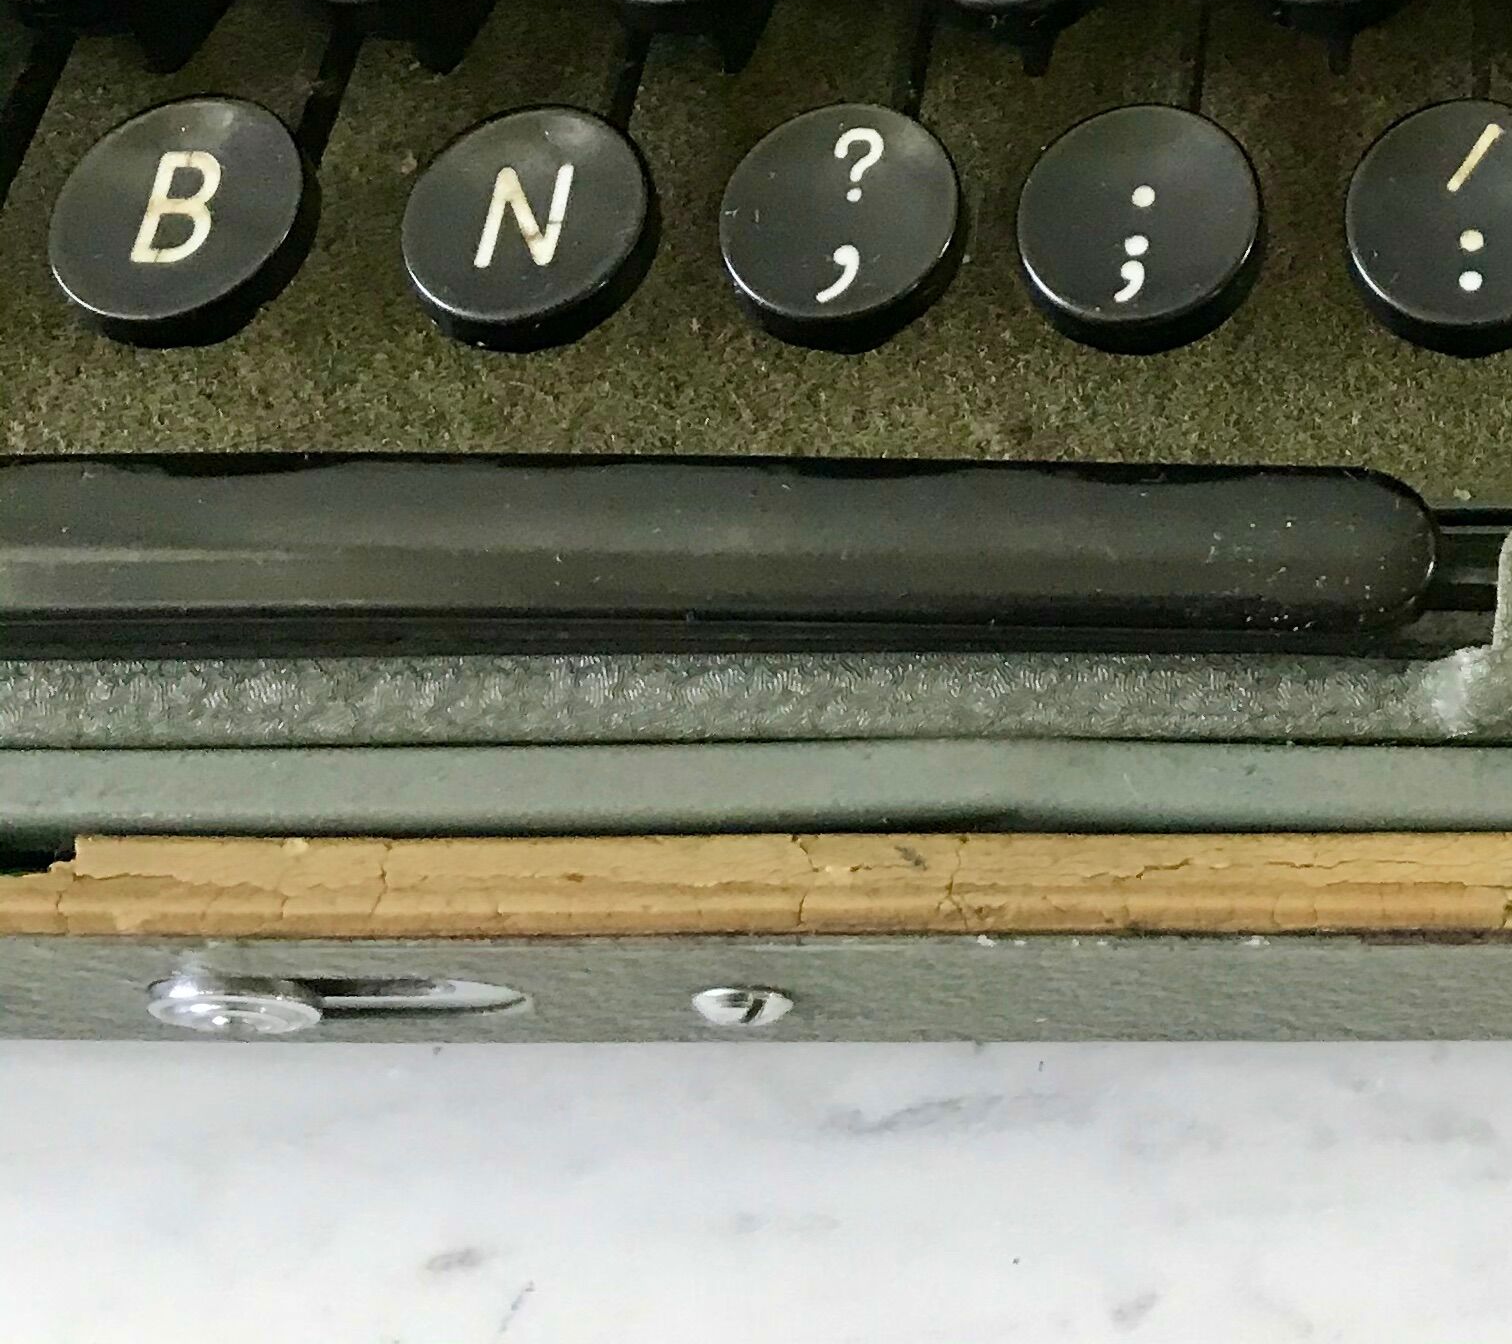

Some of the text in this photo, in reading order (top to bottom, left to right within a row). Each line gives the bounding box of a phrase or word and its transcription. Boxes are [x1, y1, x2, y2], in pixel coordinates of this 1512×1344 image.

[833, 127, 885, 203] ?
[1446, 123, 1505, 193] /
[129, 150, 222, 264] B
[473, 161, 575, 269] N
[815, 244, 860, 304] ,
[1458, 229, 1484, 293] :
